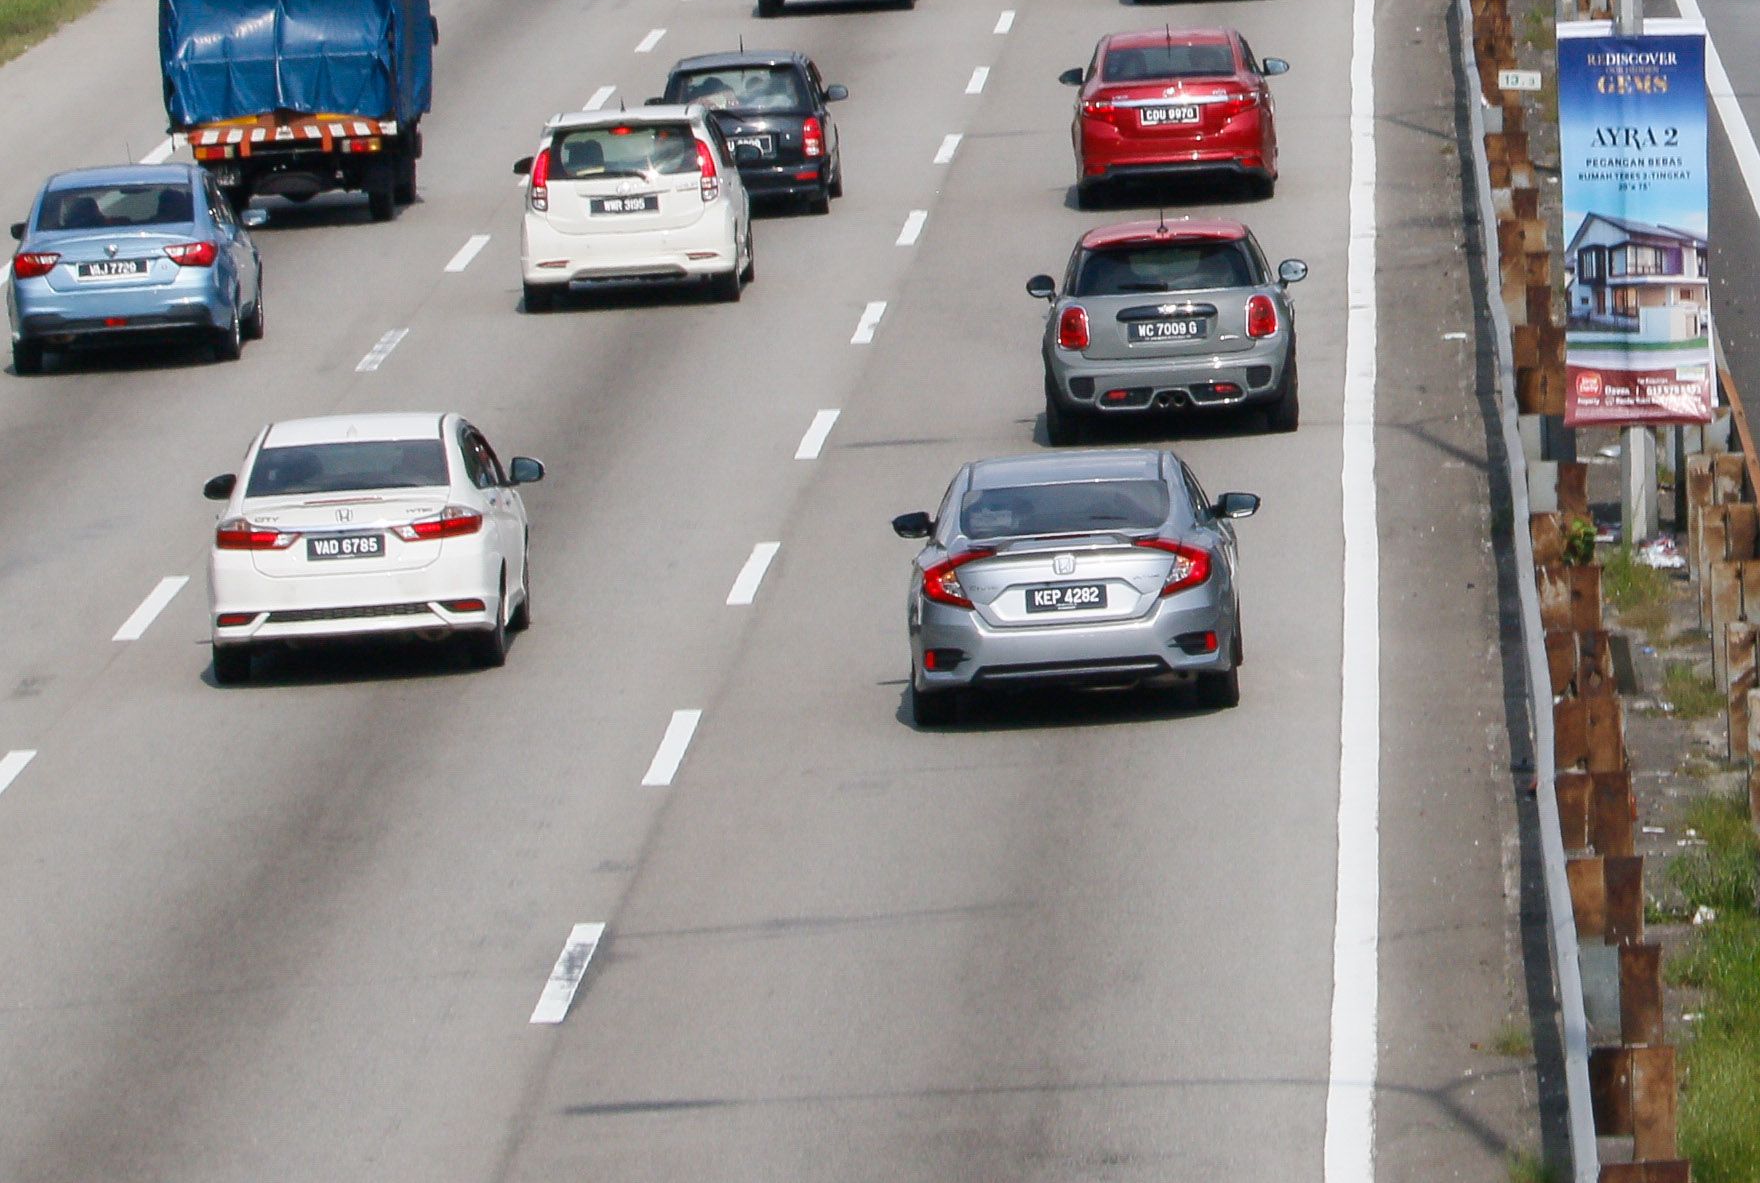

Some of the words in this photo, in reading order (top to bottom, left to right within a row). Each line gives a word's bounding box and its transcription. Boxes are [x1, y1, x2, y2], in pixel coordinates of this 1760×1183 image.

[1587, 51, 1677, 66] REDISCOVER
[1597, 74, 1669, 95] GEMS
[1591, 125, 1658, 151] AYRA
[1663, 126, 1679, 147] 2
[1586, 157, 1645, 167] PEGANGAN
[1138, 324, 1154, 337] WC
[1156, 321, 1187, 335] 7009
[1188, 321, 1198, 334] G
[314, 539, 338, 555] VAD
[342, 538, 378, 553] 6785
[1034, 590, 1061, 606] KEP
[1064, 586, 1100, 604] 4282
